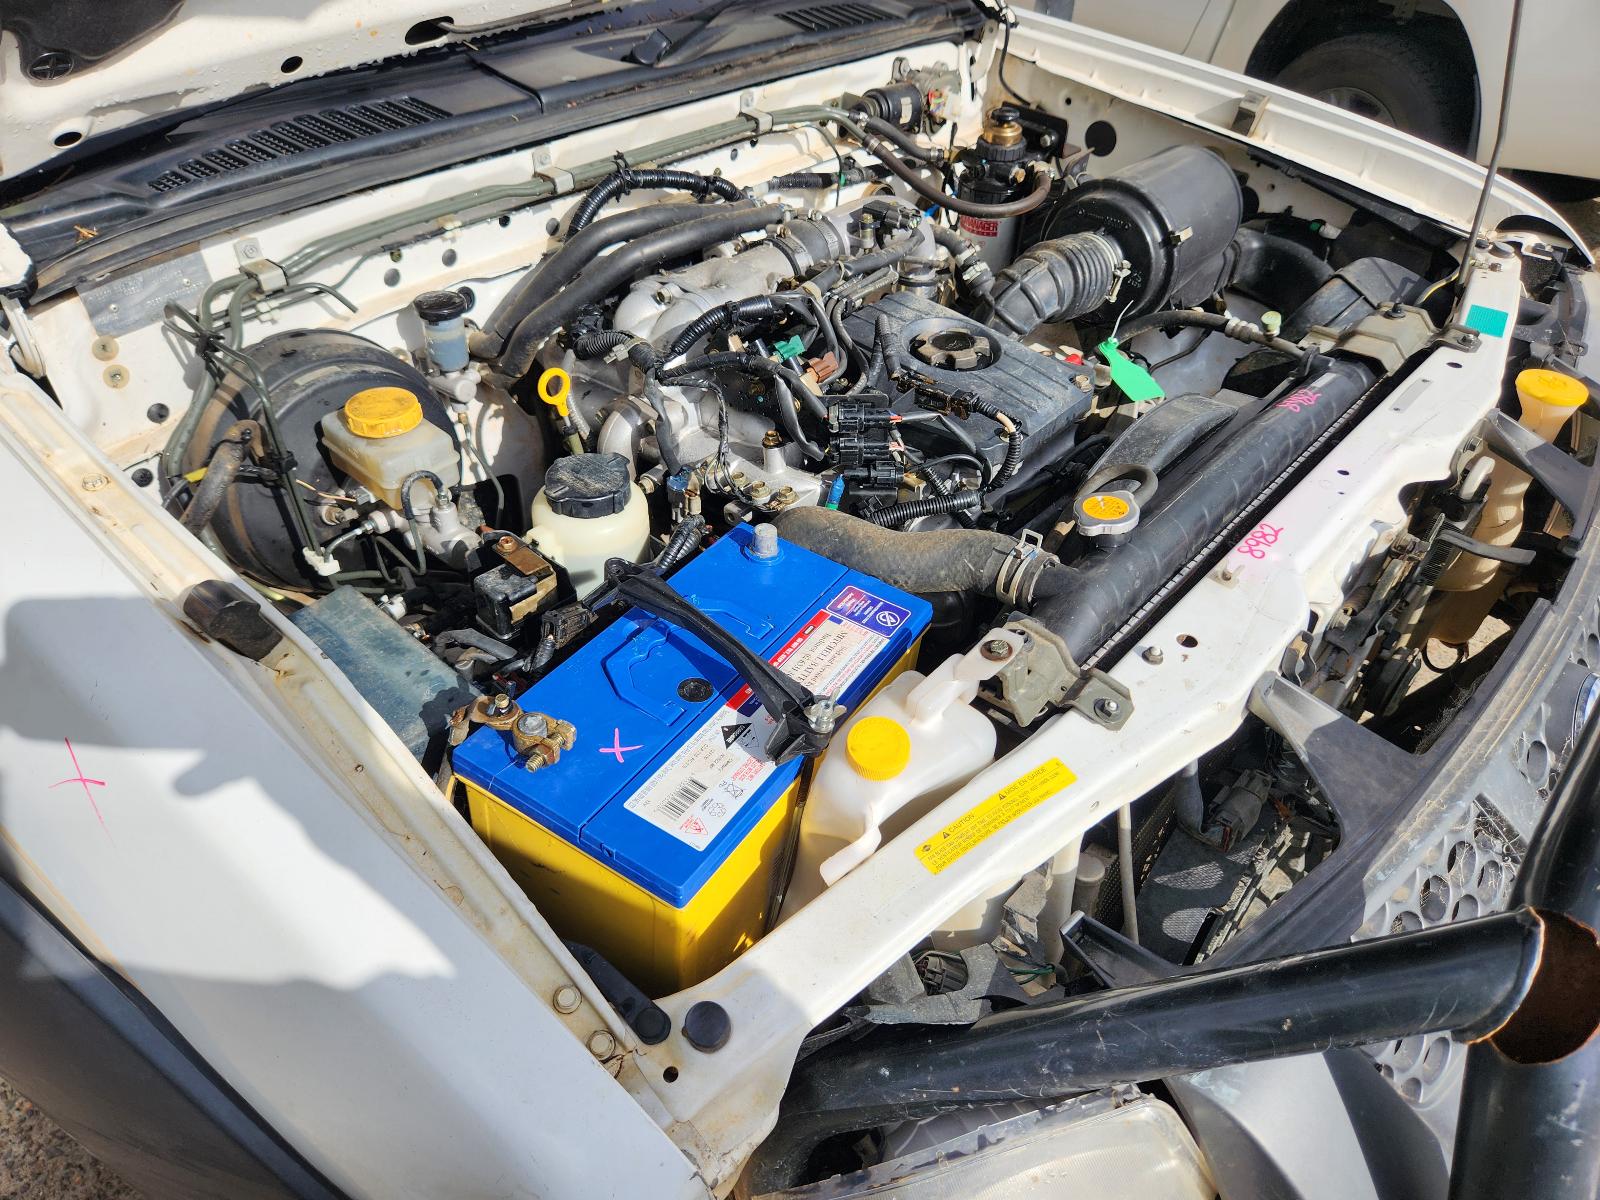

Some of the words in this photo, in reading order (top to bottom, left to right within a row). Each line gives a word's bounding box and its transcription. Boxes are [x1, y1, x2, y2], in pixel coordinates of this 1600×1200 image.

[1237, 524, 1283, 559] 8982
[814, 630, 848, 662] MITCHELL
[1017, 777, 1028, 787] EN
[947, 812, 975, 833] CAUTION
